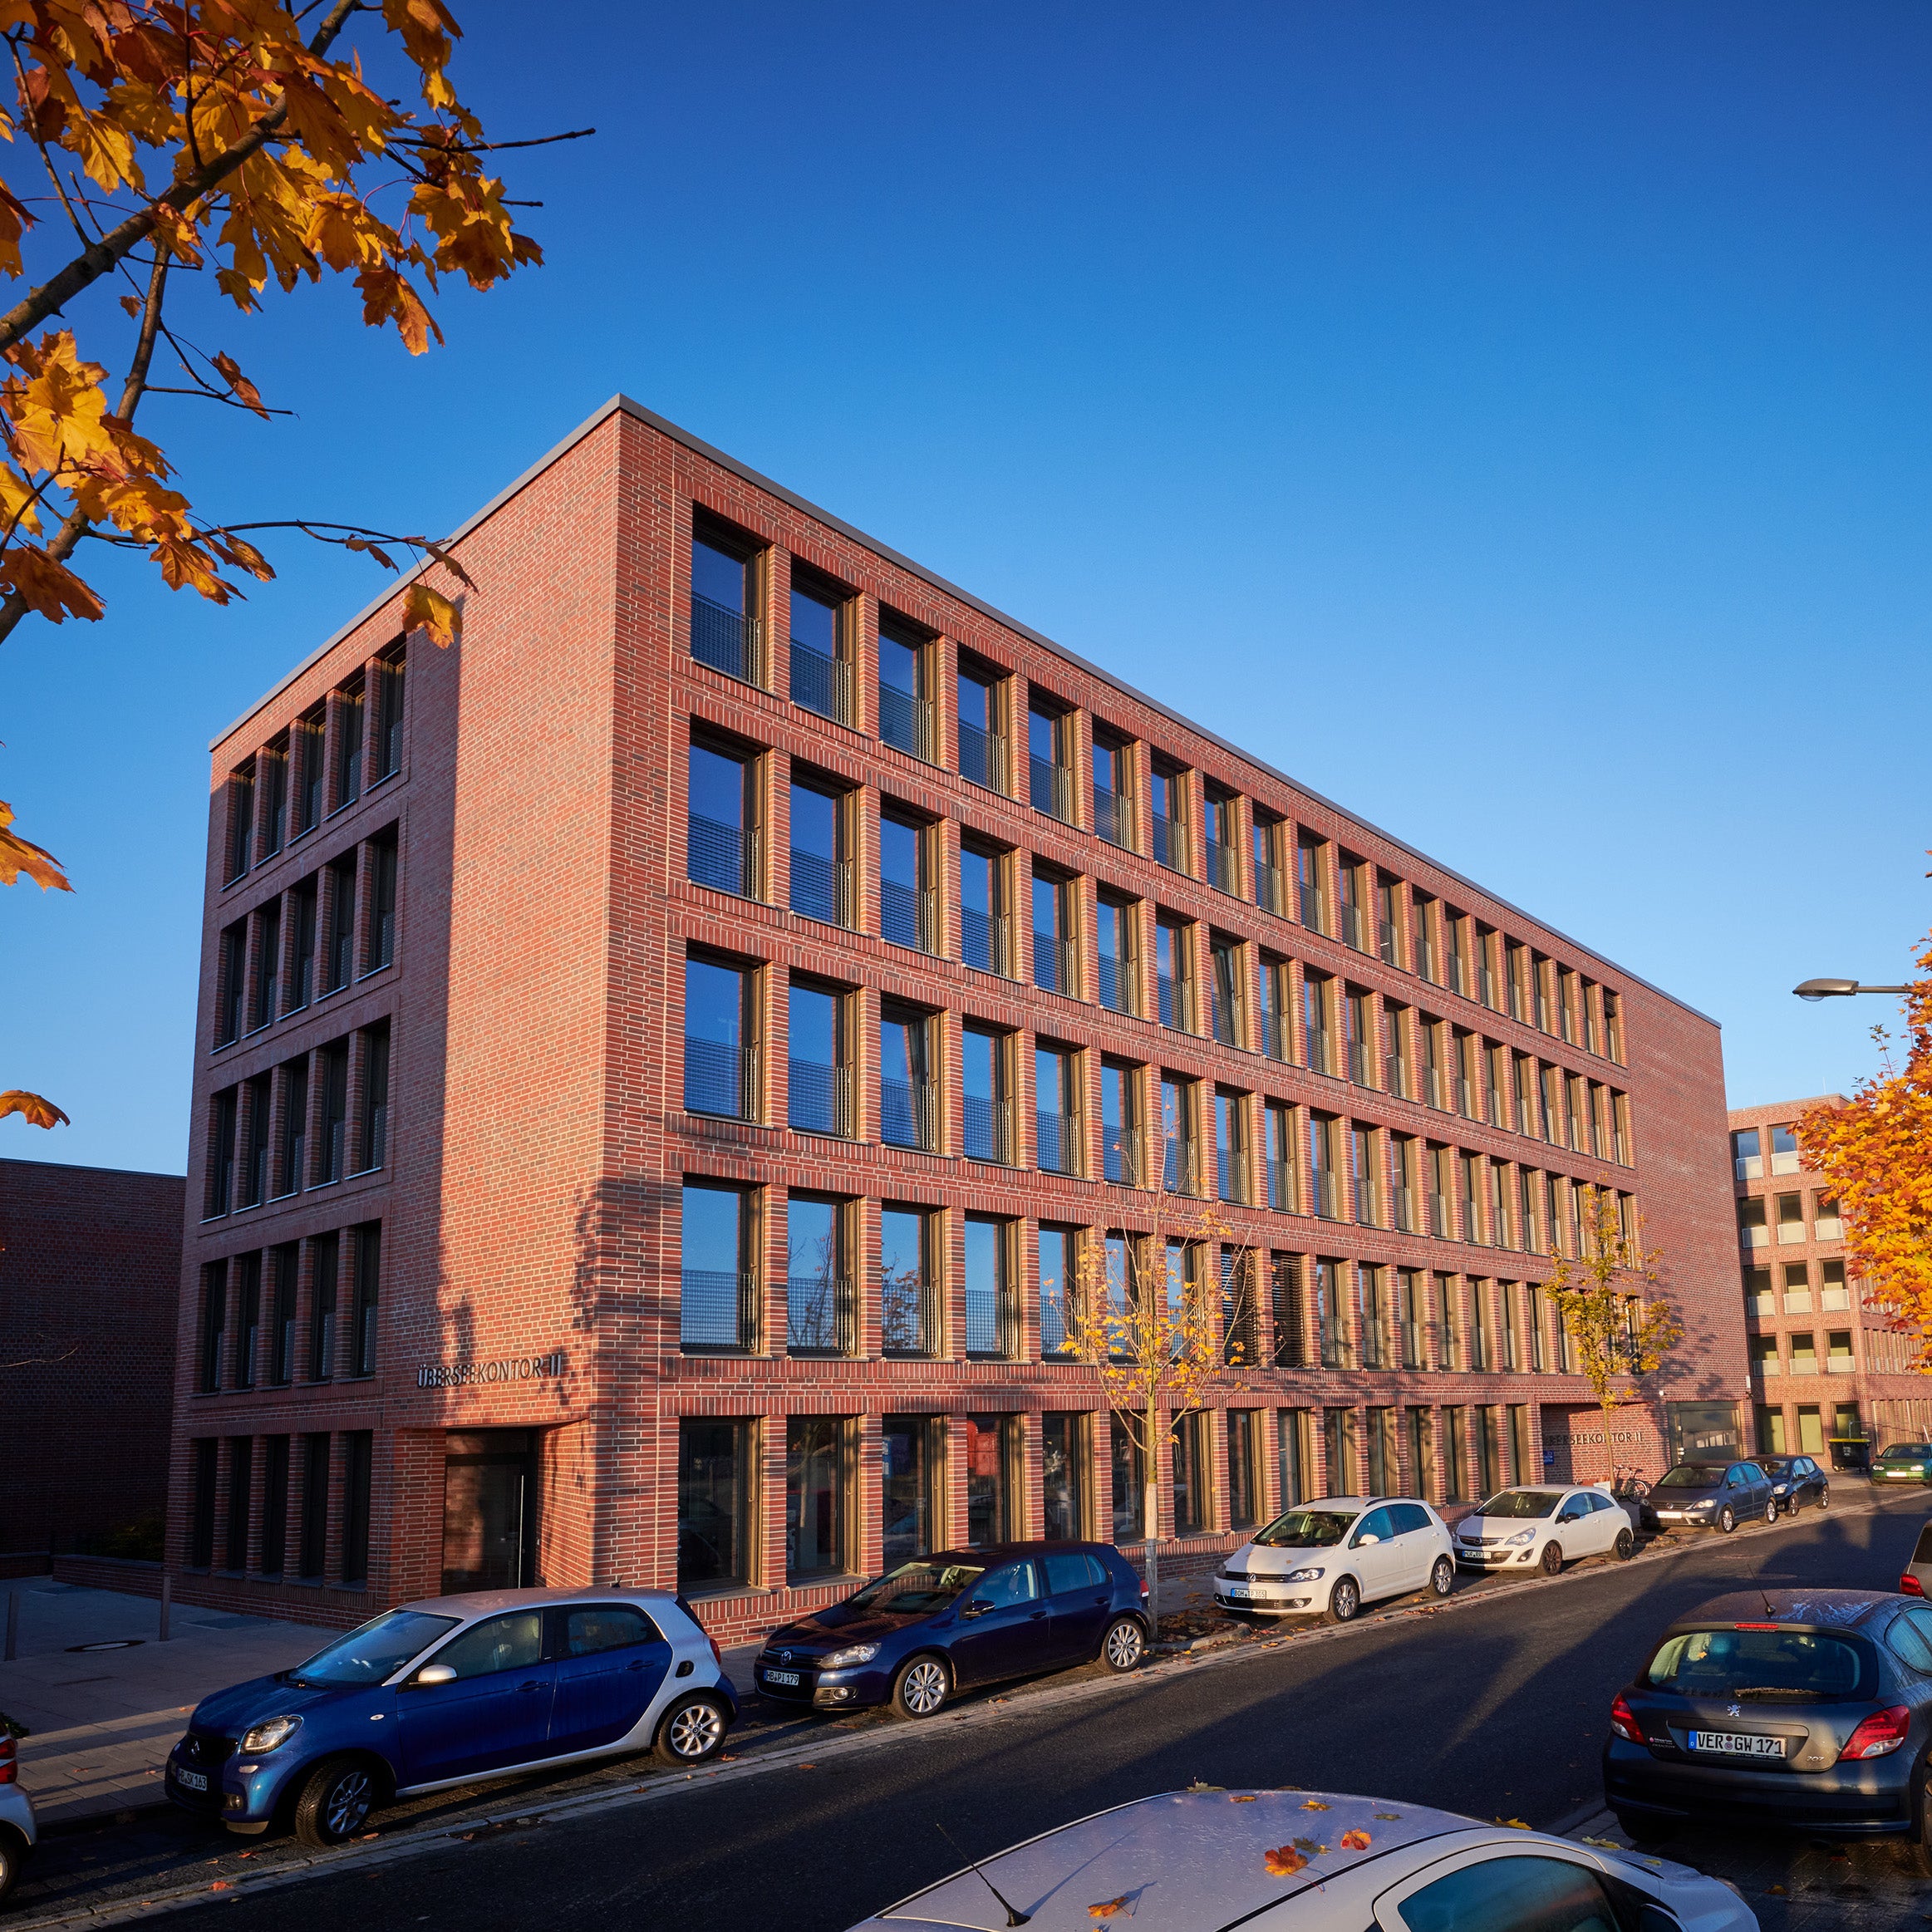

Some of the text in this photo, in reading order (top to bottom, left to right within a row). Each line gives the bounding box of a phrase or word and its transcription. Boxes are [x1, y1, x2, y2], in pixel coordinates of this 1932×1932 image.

[417, 1354, 562, 1388] ÜBERSEEKONTOR II
[1635, 1432, 1643, 1443] II
[767, 1671, 798, 1684] HB PI 179
[1698, 1733, 1783, 1754] VER GW 171
